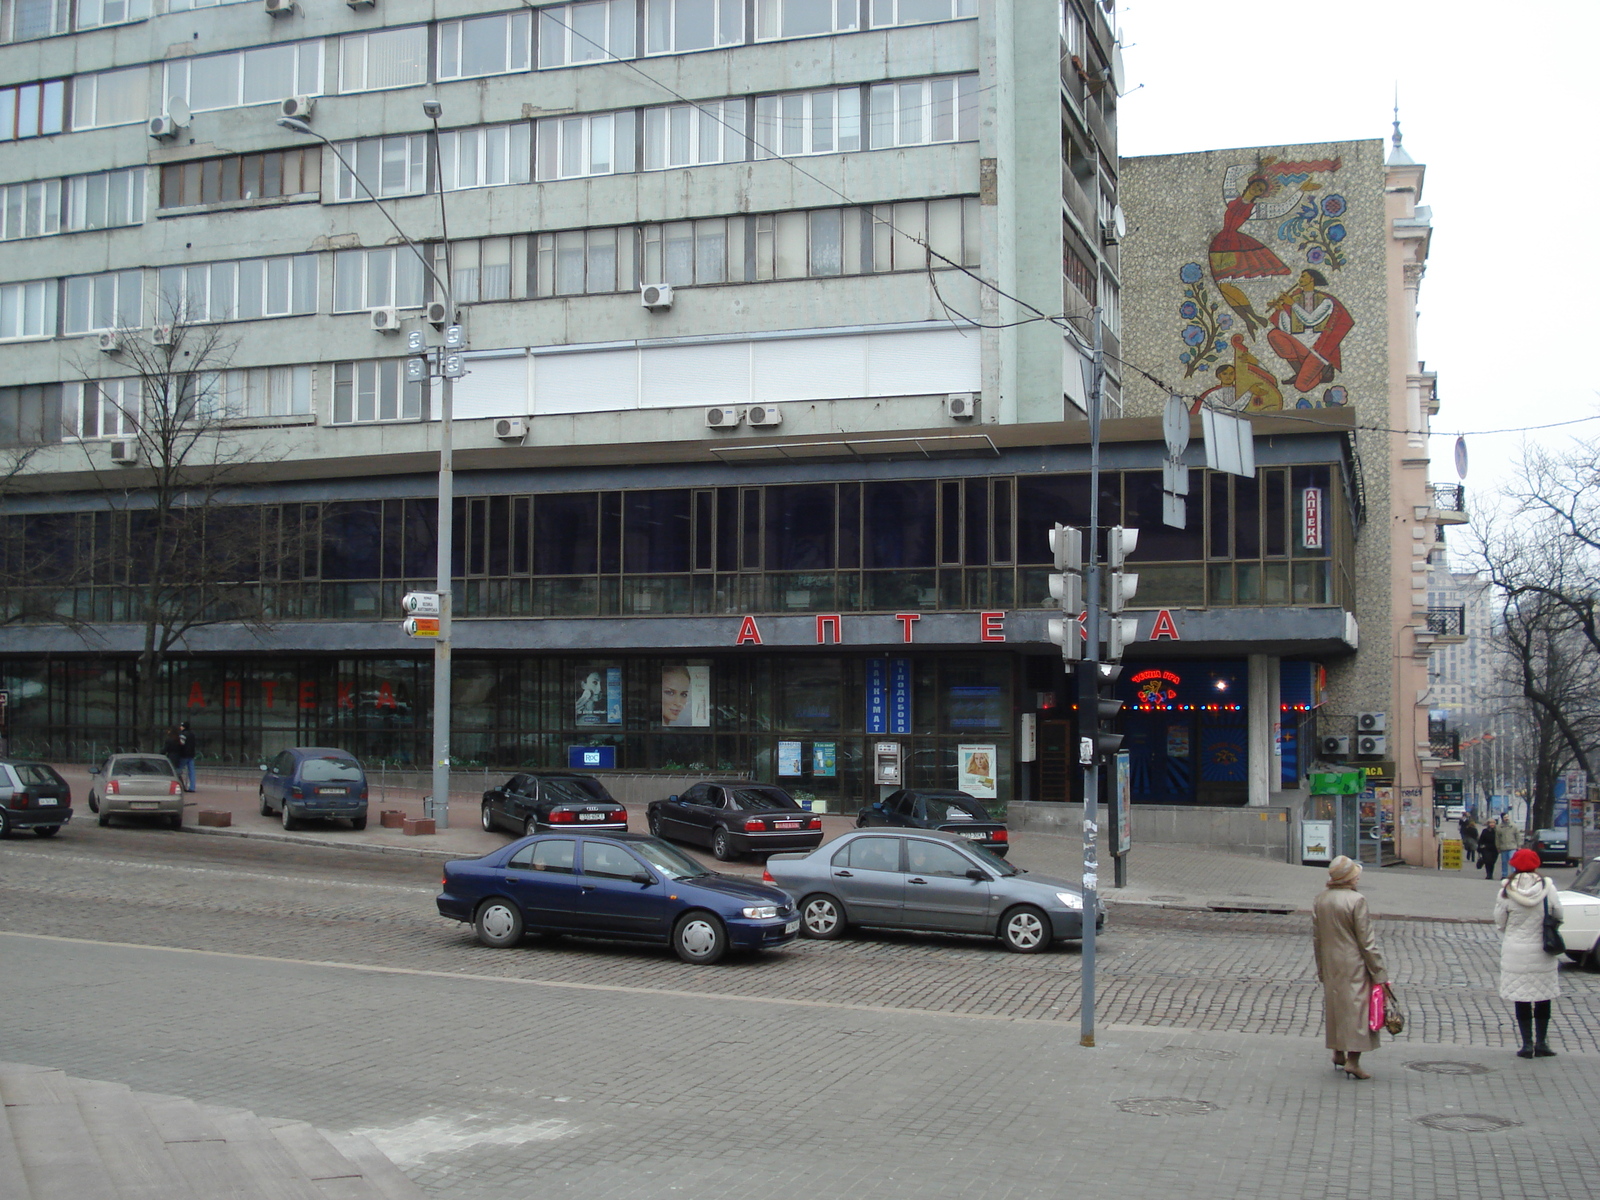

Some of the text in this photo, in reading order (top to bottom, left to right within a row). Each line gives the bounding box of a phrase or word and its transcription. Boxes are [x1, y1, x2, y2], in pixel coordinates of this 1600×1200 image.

[1306, 491, 1316, 545] АПТЕКА
[187, 680, 397, 709] АПТЕКА
[872, 660, 881, 732] БАНКОМАТ
[896, 660, 905, 733] ЦІЛОДОБОВО
